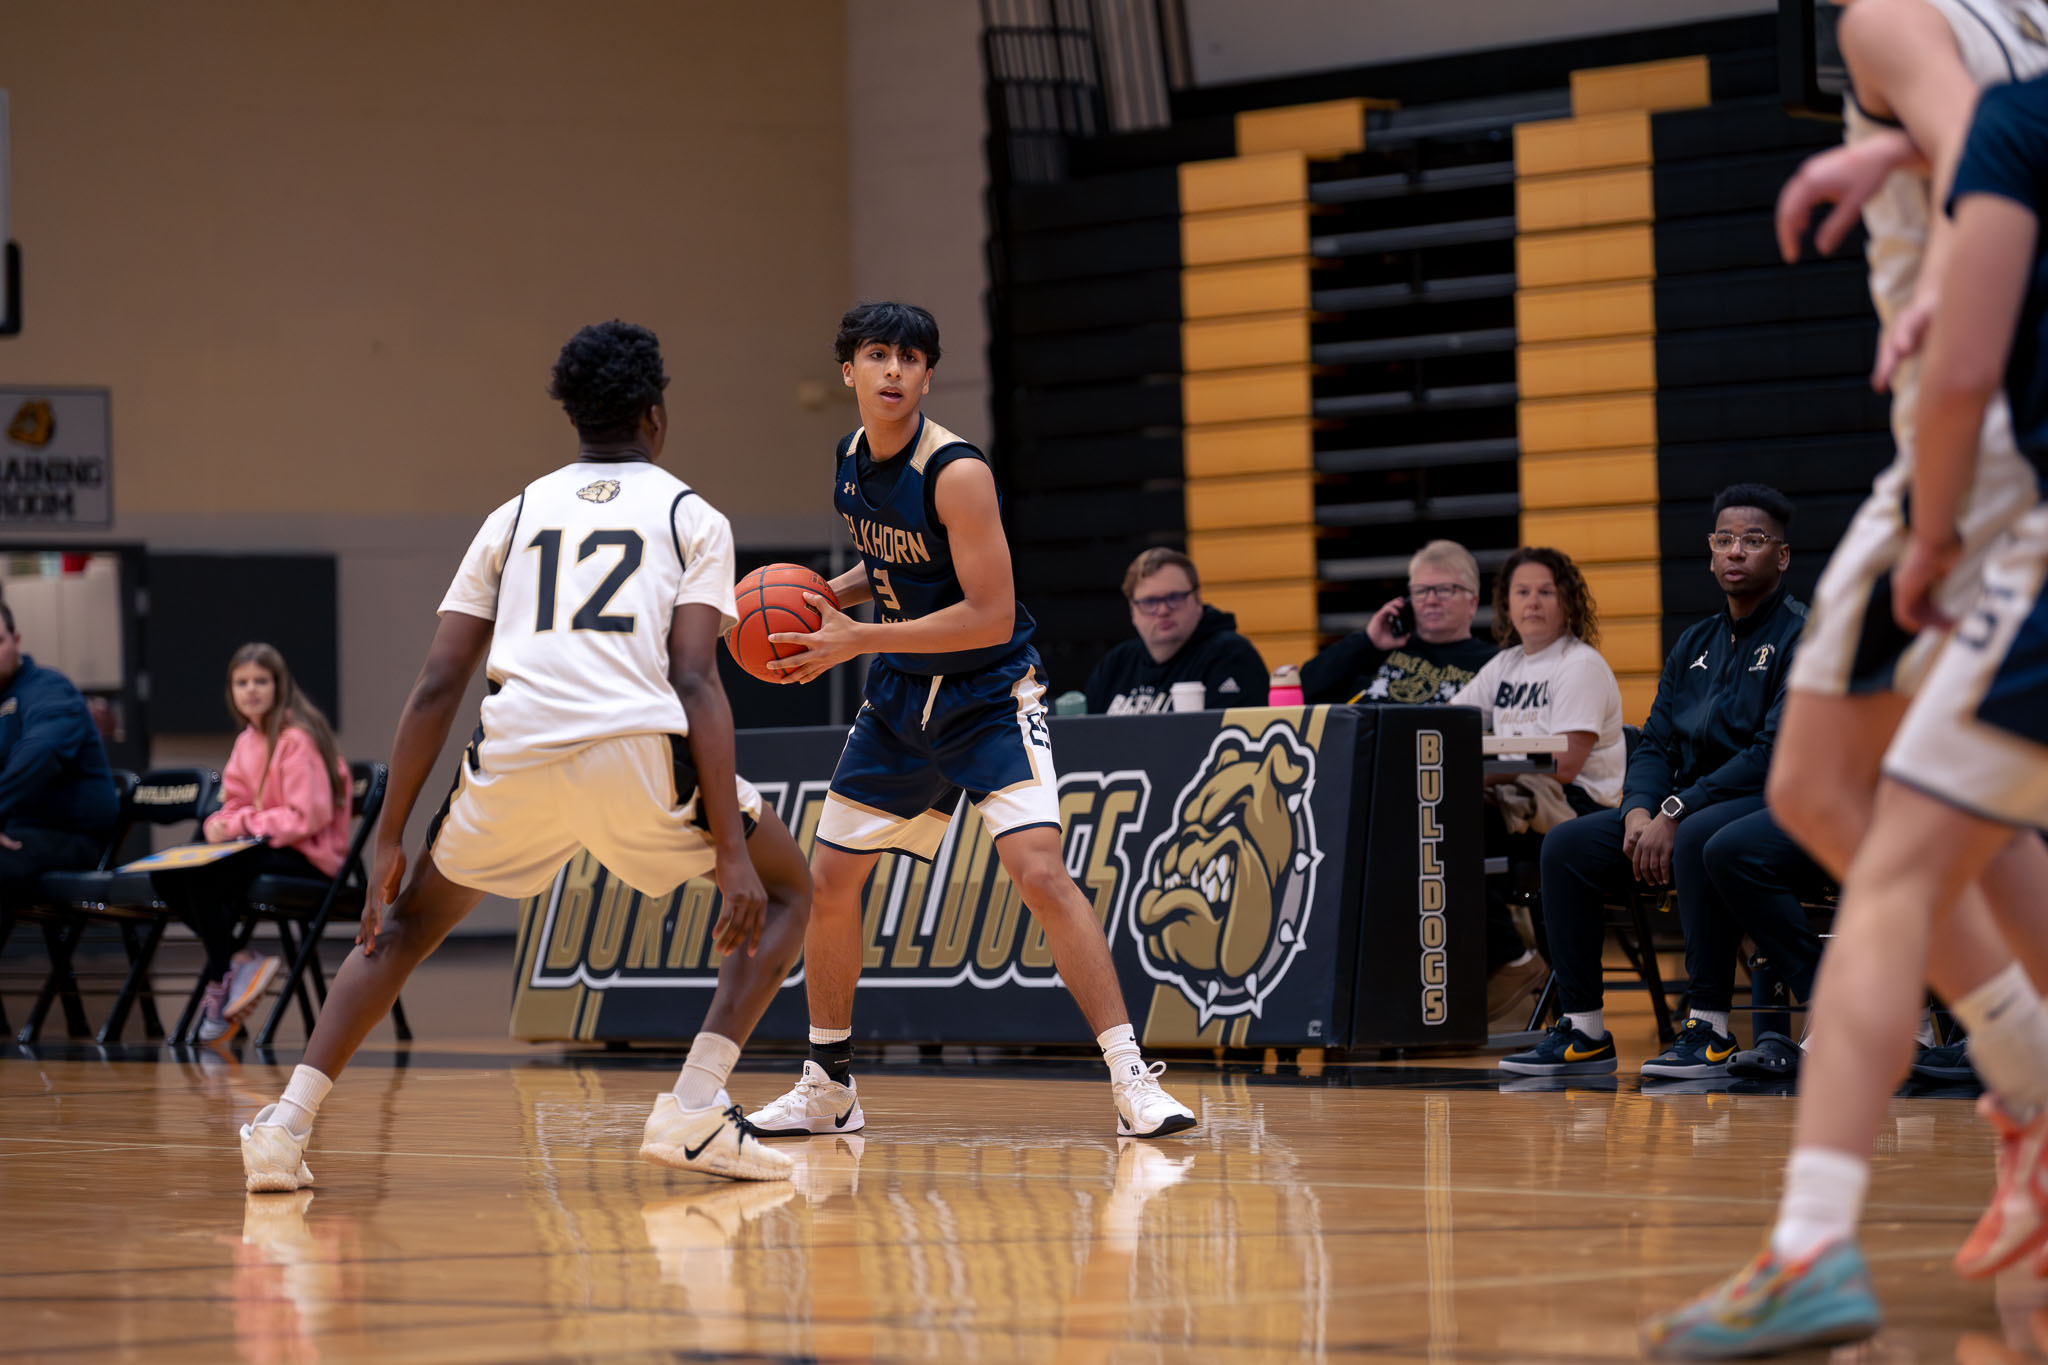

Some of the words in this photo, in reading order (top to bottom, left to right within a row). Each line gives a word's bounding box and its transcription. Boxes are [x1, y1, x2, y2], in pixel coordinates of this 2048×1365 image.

[0, 456, 103, 490] AINING
[523, 527, 646, 634] 12
[1417, 731, 1447, 1023] BULLDOGS
